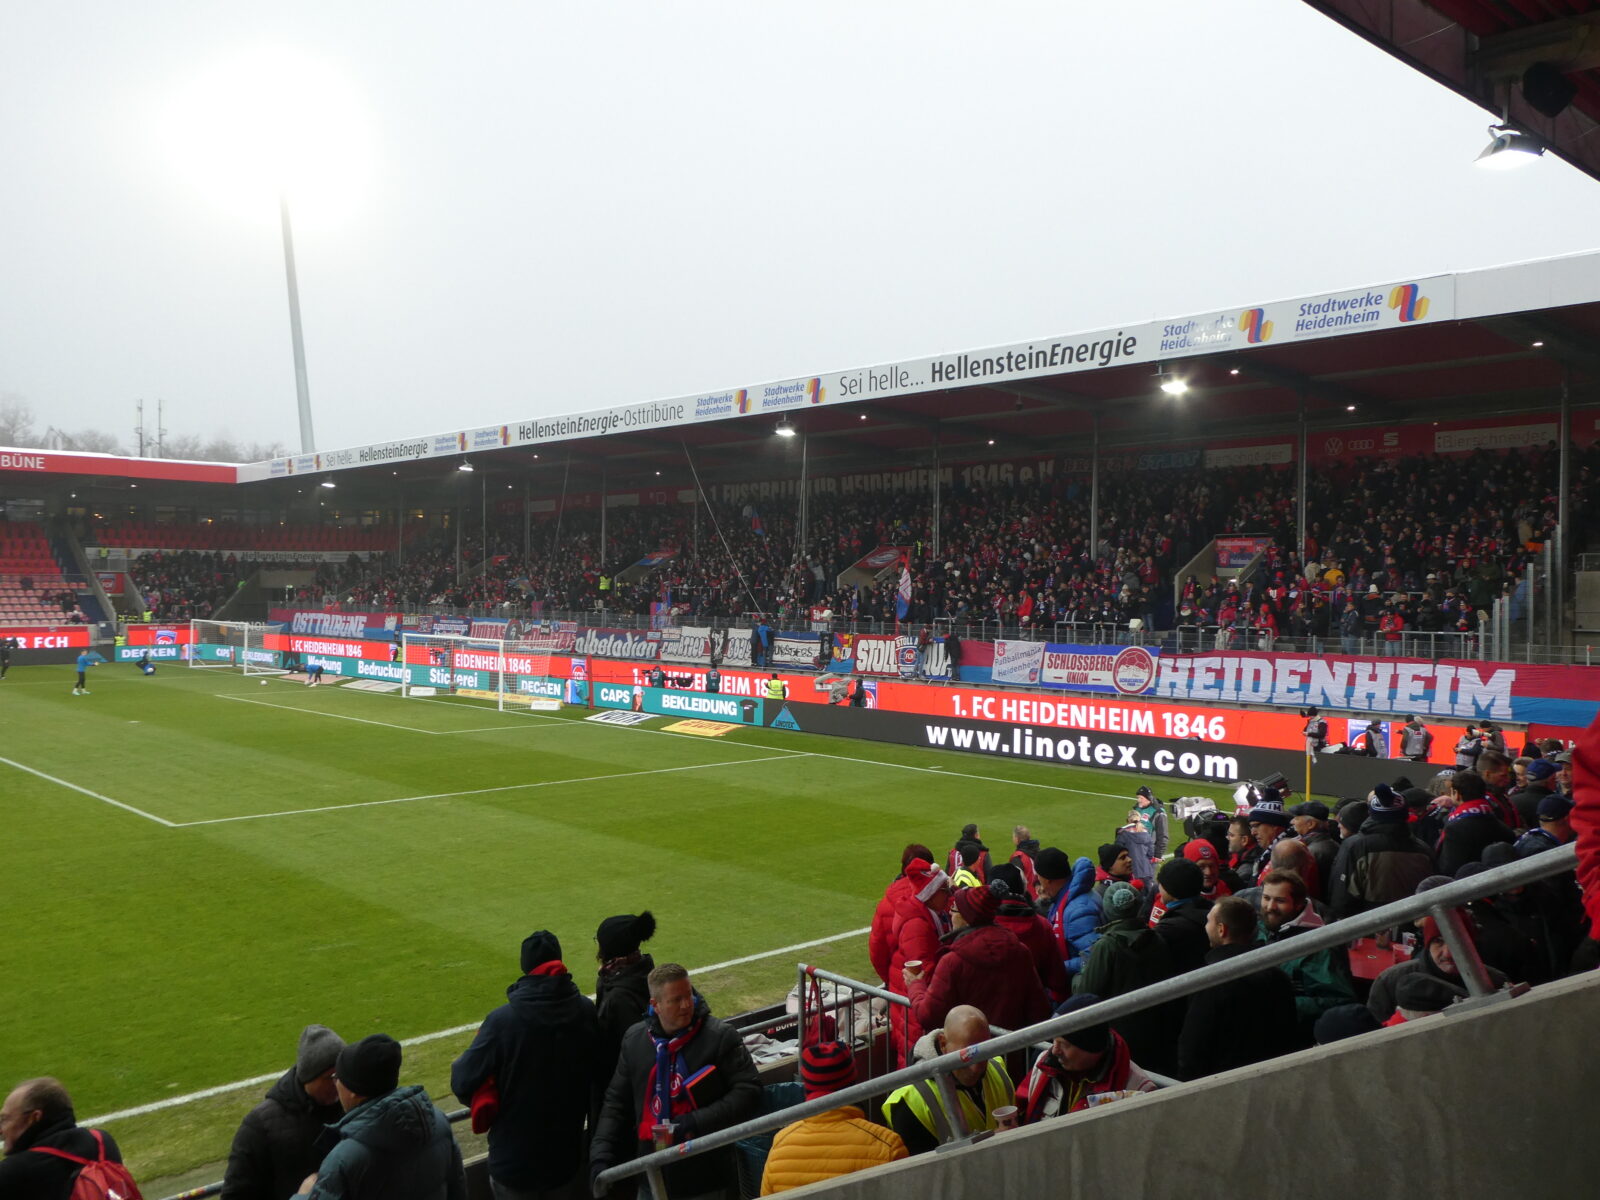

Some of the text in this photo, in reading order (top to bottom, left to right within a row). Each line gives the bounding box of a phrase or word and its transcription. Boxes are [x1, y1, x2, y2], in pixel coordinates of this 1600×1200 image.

[1299, 292, 1384, 316] Stadtwerke
[1295, 309, 1380, 331] Heidenheim
[839, 331, 1137, 396] Sei helle... HellensteinEnergie
[764, 382, 805, 397] Stadtwerke
[696, 393, 733, 407] Stadtwerke
[762, 394, 804, 408] Heidenheim
[695, 405, 732, 417] Heidenheim
[359, 441, 428, 462] HellensteinEnergie
[1, 453, 45, 469] BÜNE
[34, 636, 68, 648] FCH
[304, 640, 346, 656] HEIDENHEIM
[346, 644, 362, 657] 1846
[856, 639, 898, 673] STOLL
[1048, 654, 1113, 672] SCHLOSSBERG
[357, 660, 411, 683] Bedruckung
[509, 658, 531, 673] 1846
[1066, 672, 1090, 684] UNION
[522, 679, 561, 696] DECKEN
[601, 688, 630, 703] CAPS
[1157, 657, 1516, 720] HEIDENHEIM
[662, 695, 737, 716] BEKLEIDUNG
[952, 695, 1226, 740] 1. FC HEIDENHEIM 1846
[926, 724, 1238, 779] www.linotex.com
